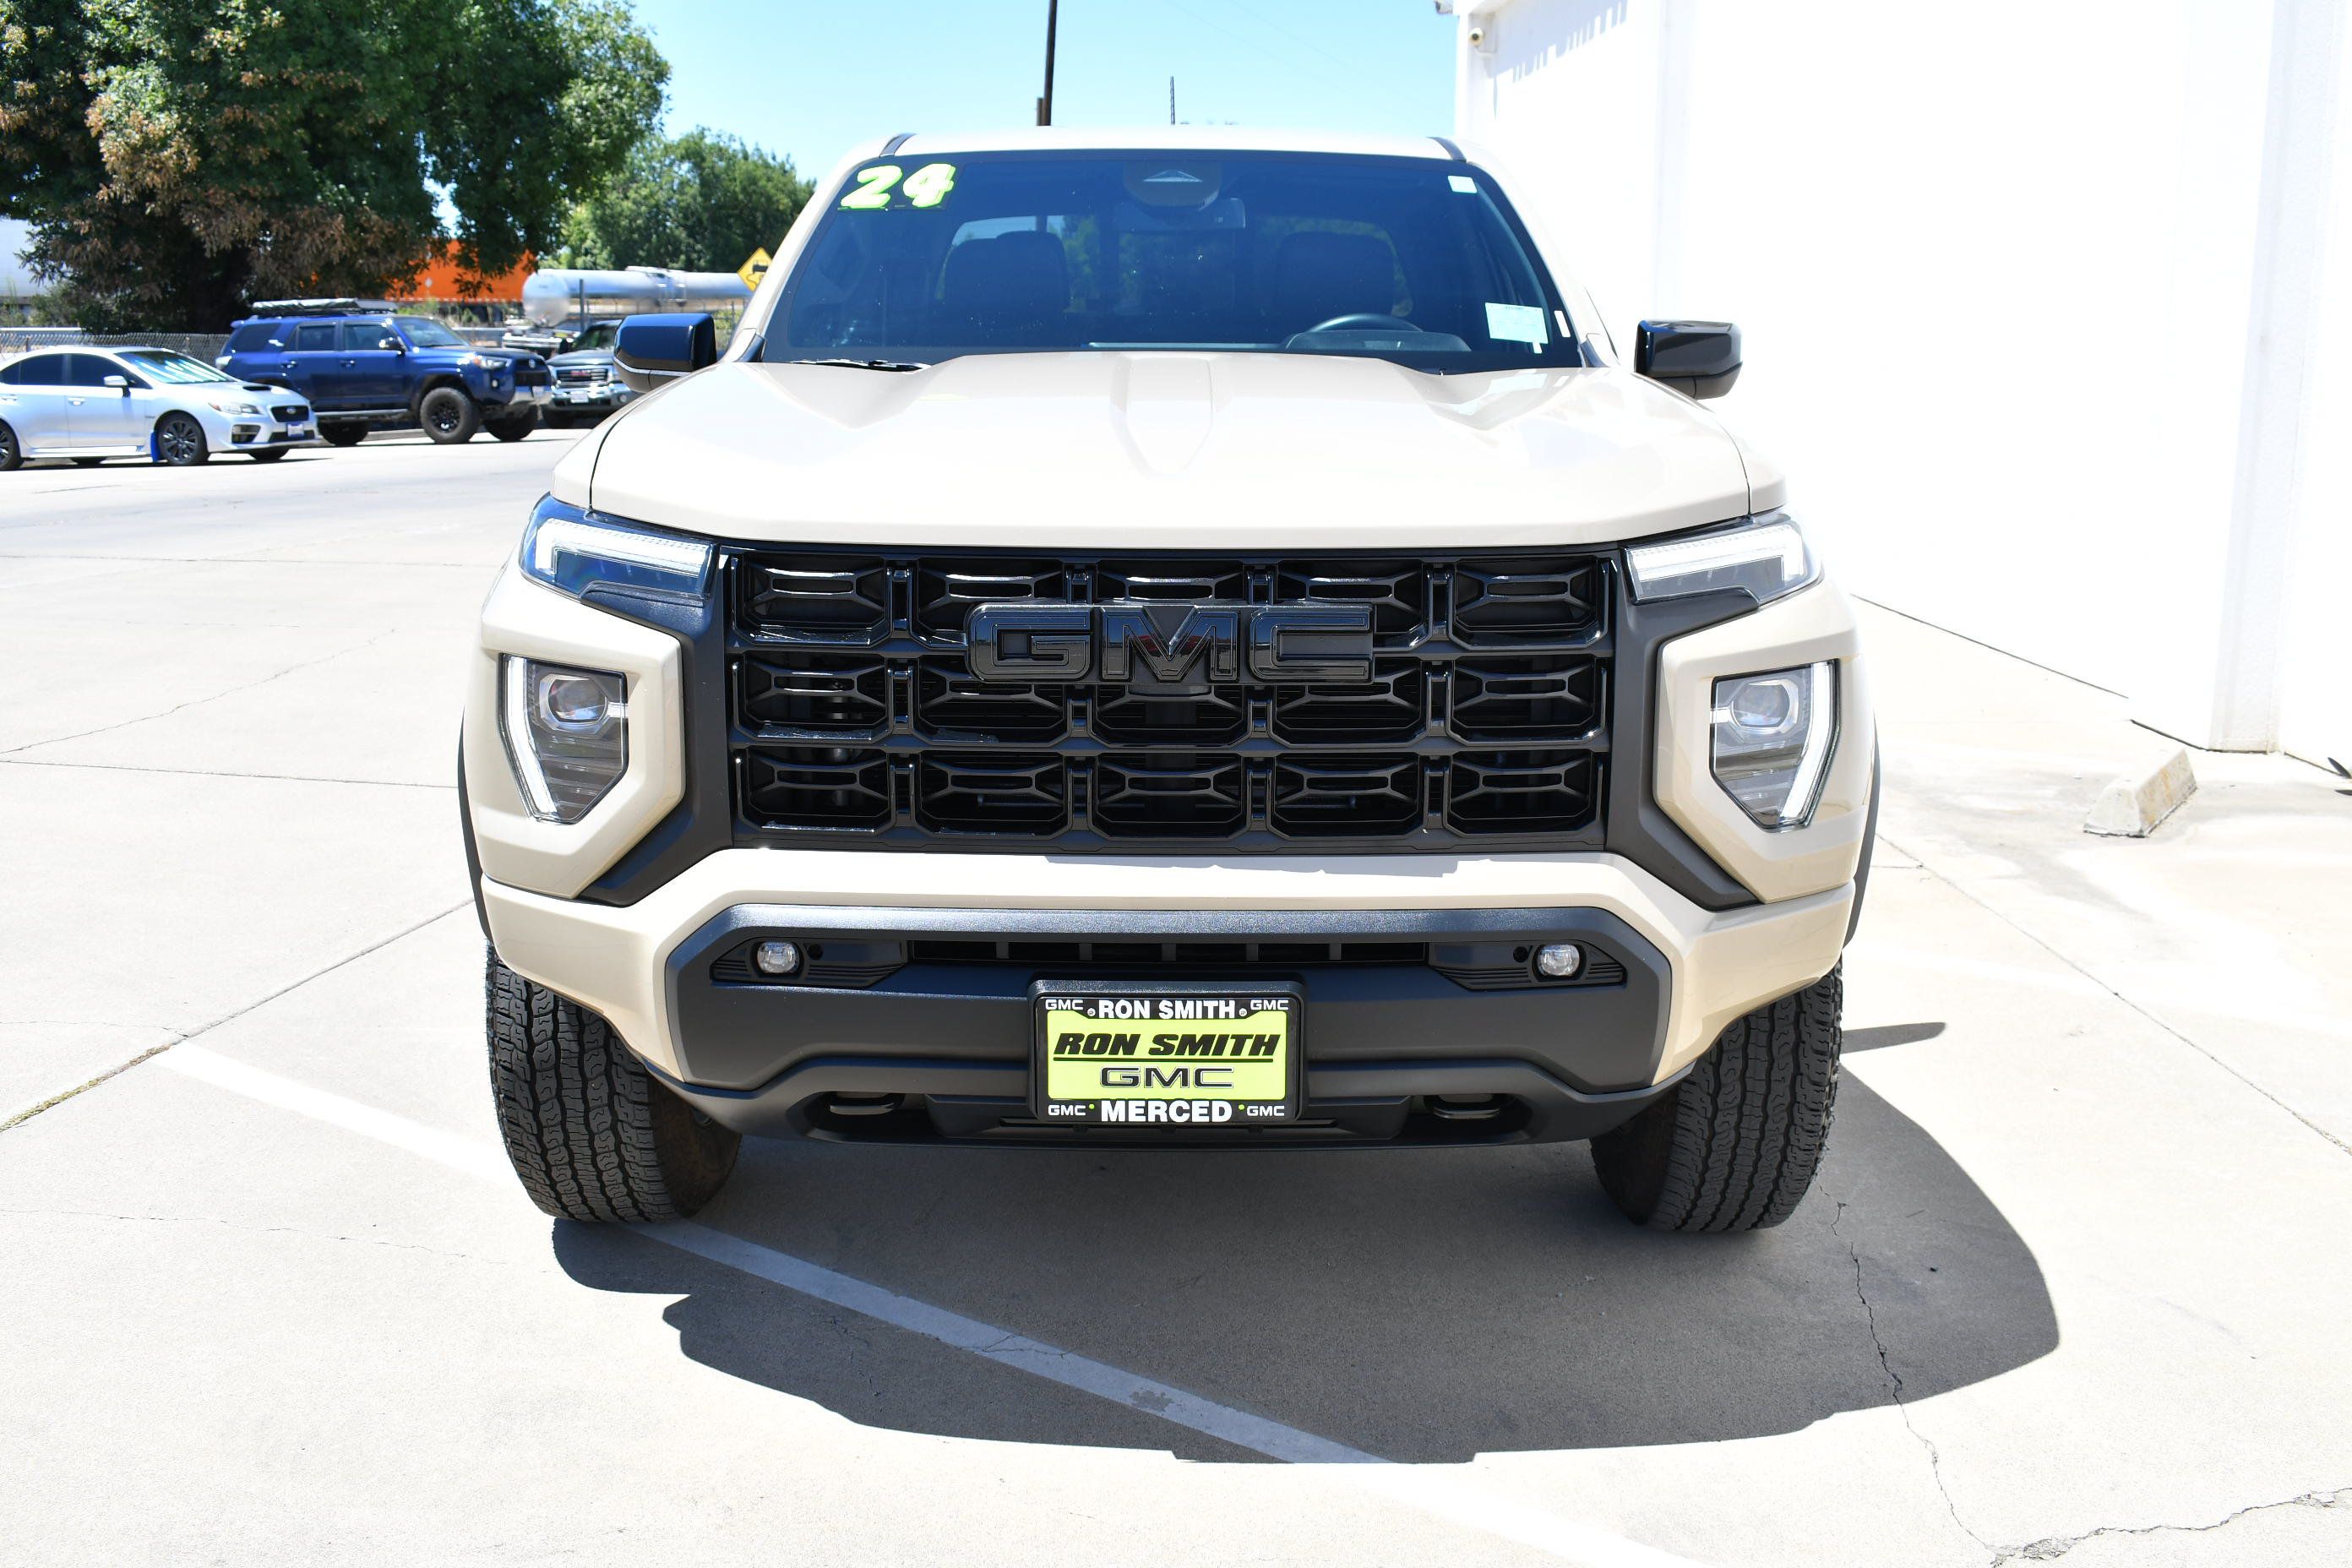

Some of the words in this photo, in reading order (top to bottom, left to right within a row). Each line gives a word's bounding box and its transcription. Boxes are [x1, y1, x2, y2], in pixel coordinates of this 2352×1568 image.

[841, 163, 956, 208] 24
[966, 602, 1375, 683] GMC
[1045, 999, 1084, 1010] GMC
[1098, 999, 1151, 1020] RON
[1158, 999, 1236, 1020] SMITH
[1250, 999, 1289, 1010] GMC
[1054, 1032, 1141, 1056] RON
[1148, 1033, 1281, 1056] SMITH
[1100, 1065, 1234, 1089] GMC
[1048, 1104, 1086, 1116] GMC
[1101, 1100, 1232, 1123] MERCED
[1246, 1105, 1285, 1117] GMC
